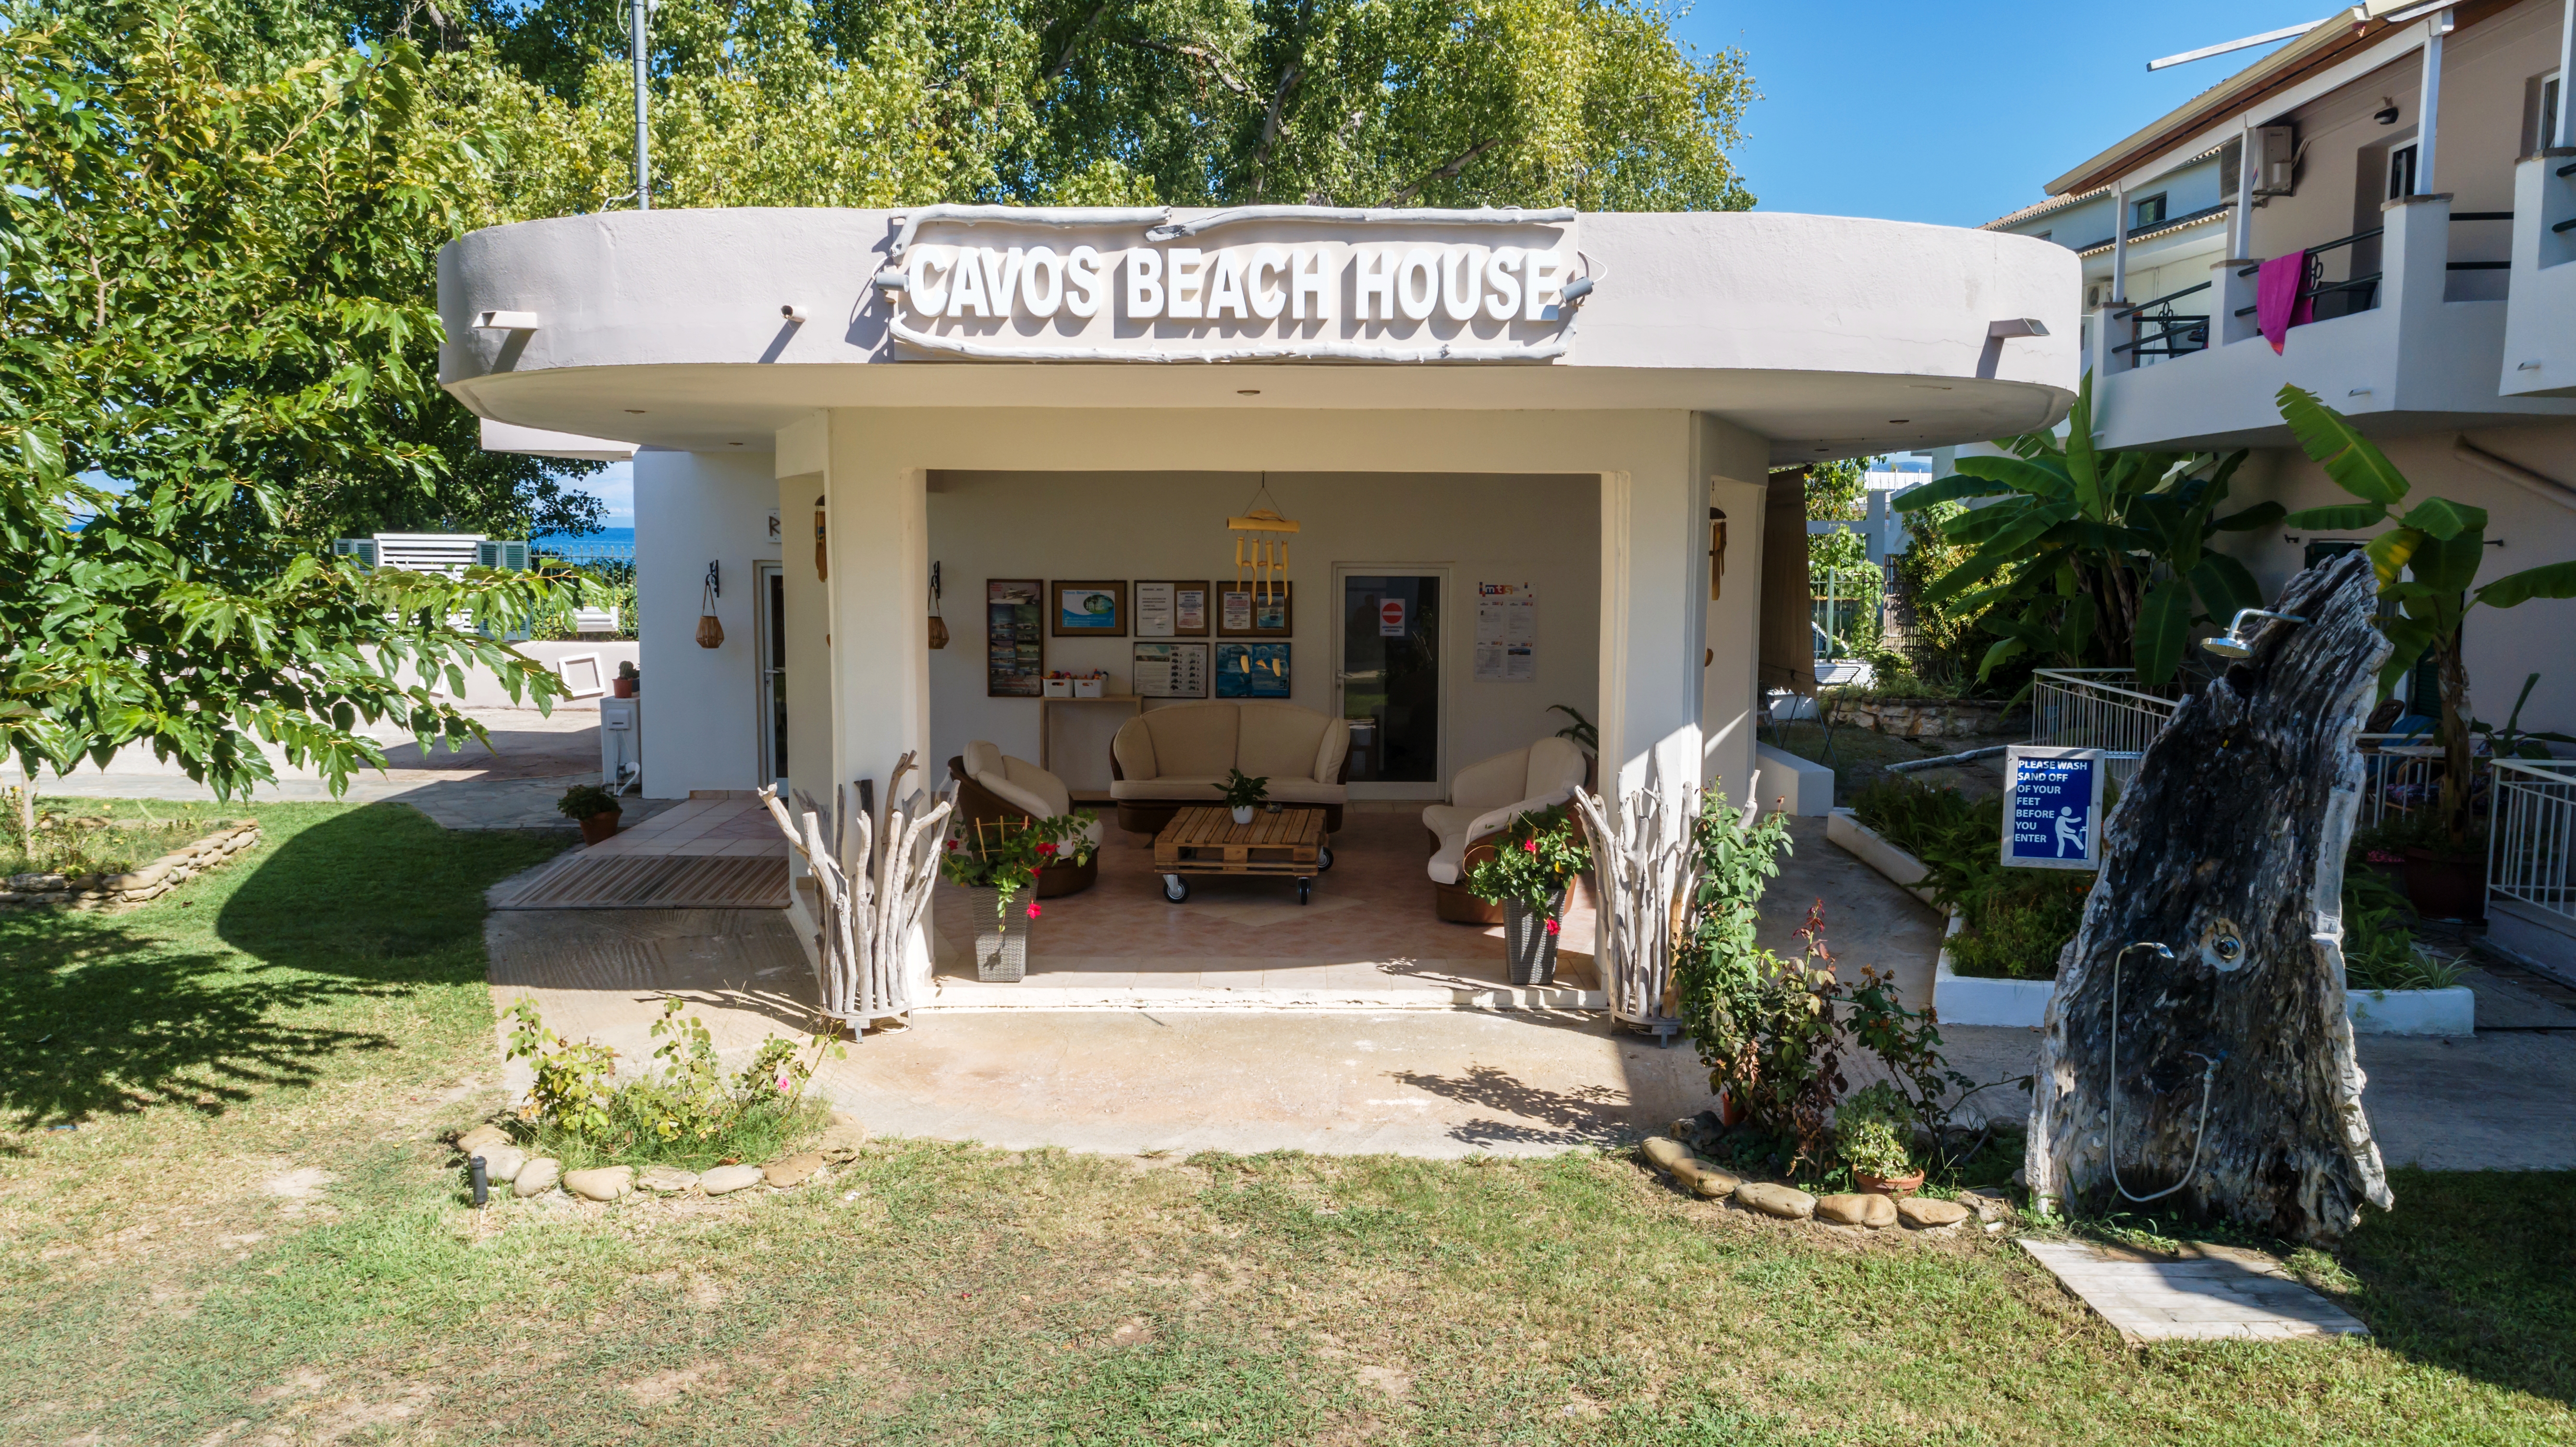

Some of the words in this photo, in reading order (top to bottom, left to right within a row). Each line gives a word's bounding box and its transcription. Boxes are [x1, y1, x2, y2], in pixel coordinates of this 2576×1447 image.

[909, 245, 1101, 318] CAVOS
[1126, 247, 1330, 320] BEACH
[1355, 248, 1561, 321] HOUSE
[1485, 584, 1512, 594] mts
[2018, 760, 2055, 769] PLEASE
[2057, 761, 2088, 770] WASH
[2017, 772, 2046, 781] SAND
[2048, 773, 2068, 782] OFF
[2017, 785, 2031, 793] OF
[2032, 785, 2061, 794] YOUR
[2016, 797, 2041, 805] FEET
[2016, 810, 2055, 819] BEFORE
[2015, 821, 2037, 830] YOU
[2014, 834, 2047, 843] ENTER
